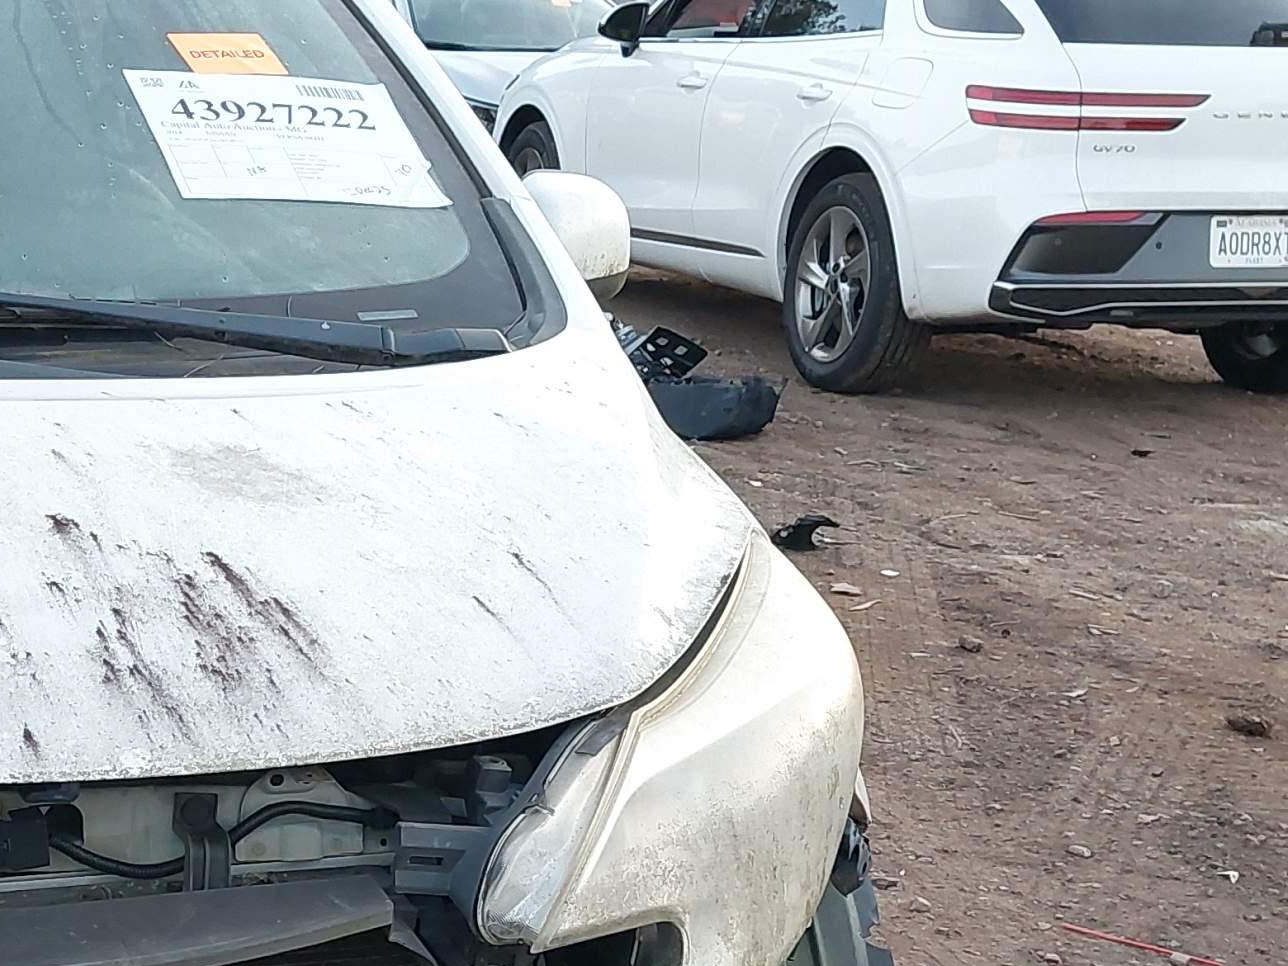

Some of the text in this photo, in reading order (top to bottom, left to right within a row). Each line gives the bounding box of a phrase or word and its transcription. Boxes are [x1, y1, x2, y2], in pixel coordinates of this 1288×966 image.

[189, 48, 265, 60] DETAILED
[170, 97, 377, 132] 43927222
[1093, 145, 1136, 153] GV70
